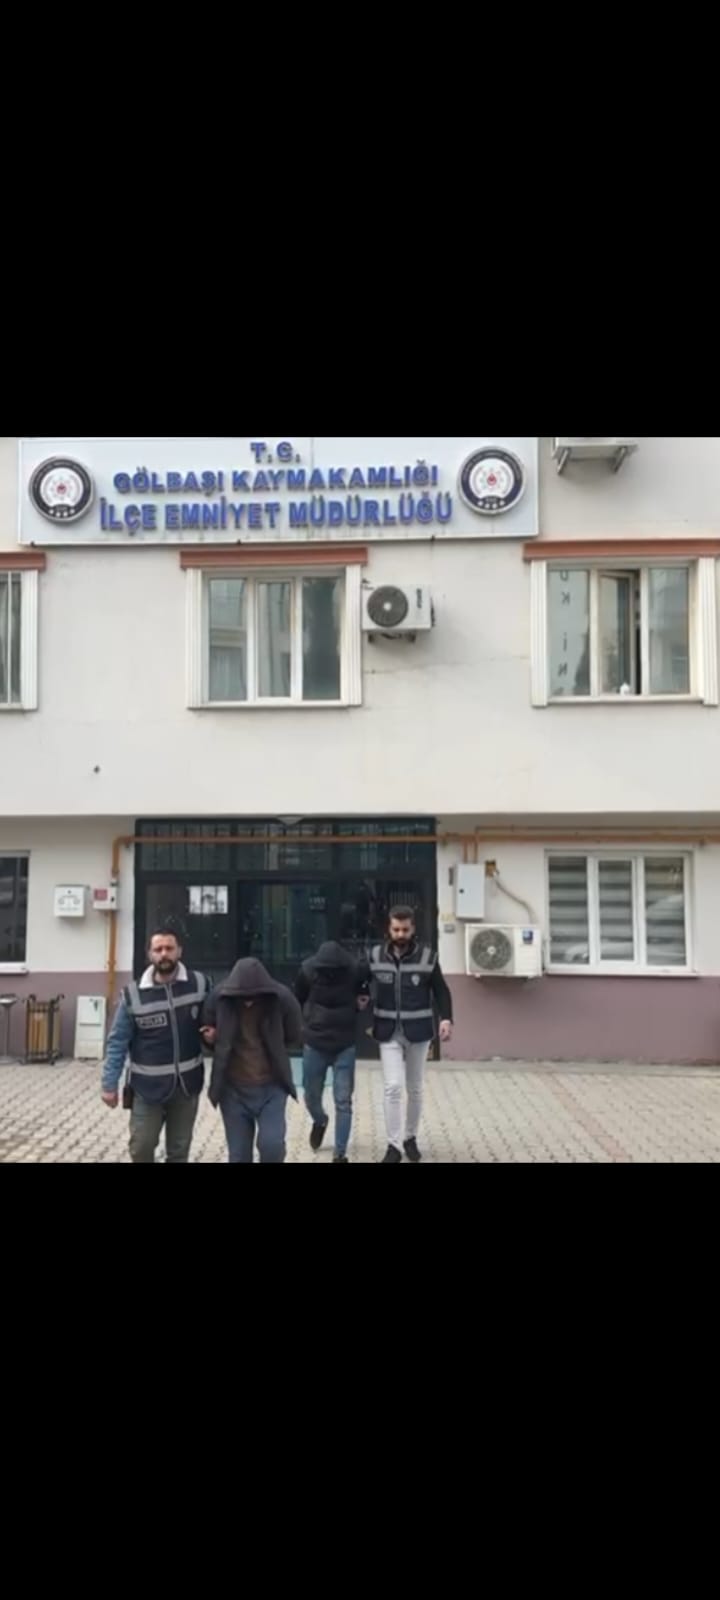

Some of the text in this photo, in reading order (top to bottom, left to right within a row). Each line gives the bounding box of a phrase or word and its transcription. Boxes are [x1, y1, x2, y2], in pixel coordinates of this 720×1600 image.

[113, 467, 224, 497] GÖLBAŞI
[231, 461, 438, 491] KAYMAKAMLIĞI
[100, 491, 453, 536] İLÇE EMNİYET MÜDÜRLÜĞÜ
